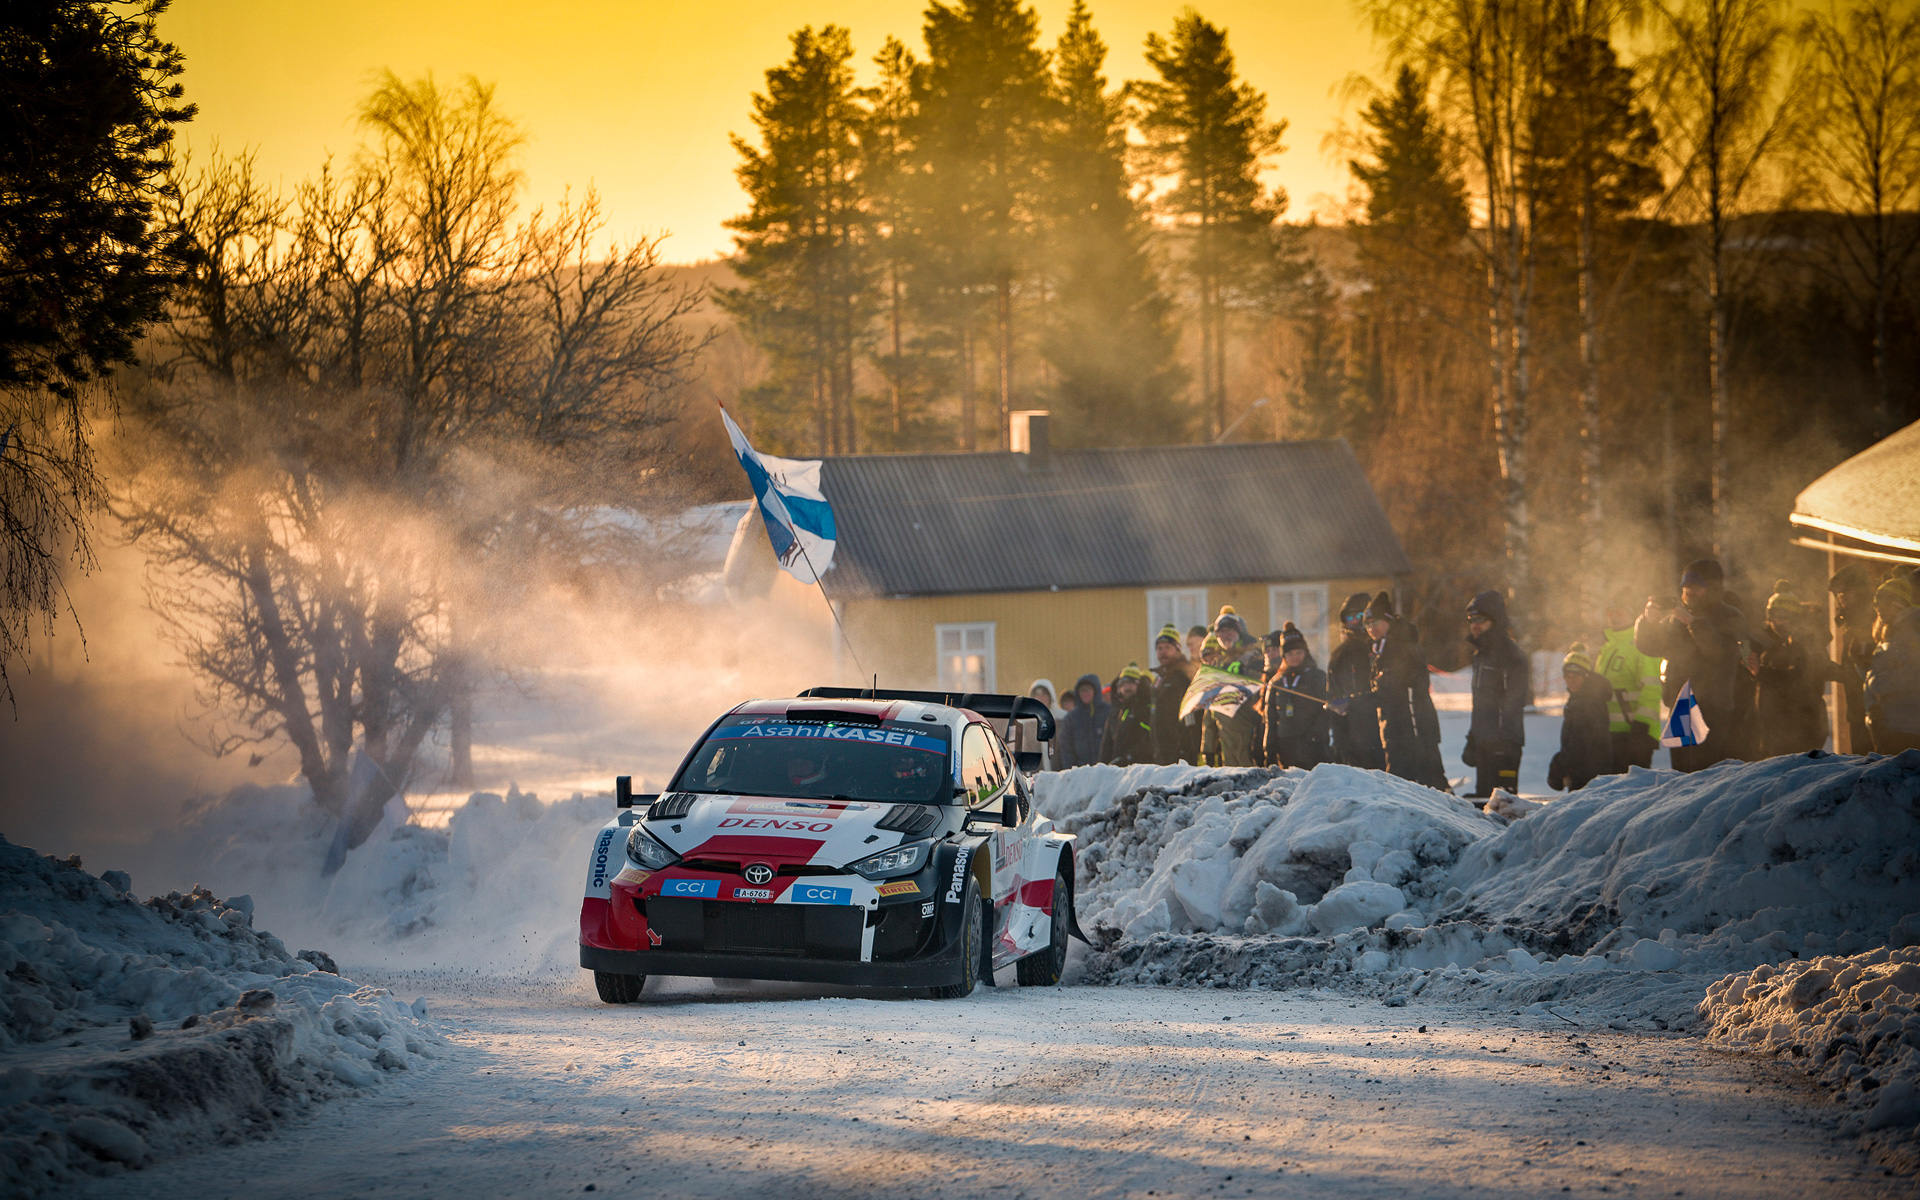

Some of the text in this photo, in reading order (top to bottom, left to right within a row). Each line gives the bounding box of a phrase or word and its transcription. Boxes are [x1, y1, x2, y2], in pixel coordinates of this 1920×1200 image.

[827, 719, 879, 729] GAZOO
[880, 724, 929, 736] Racing
[717, 818, 834, 833] DENSO
[741, 890, 768, 898] A-6765
[878, 882, 917, 896] PIRELLI
[921, 903, 935, 916] OMP
